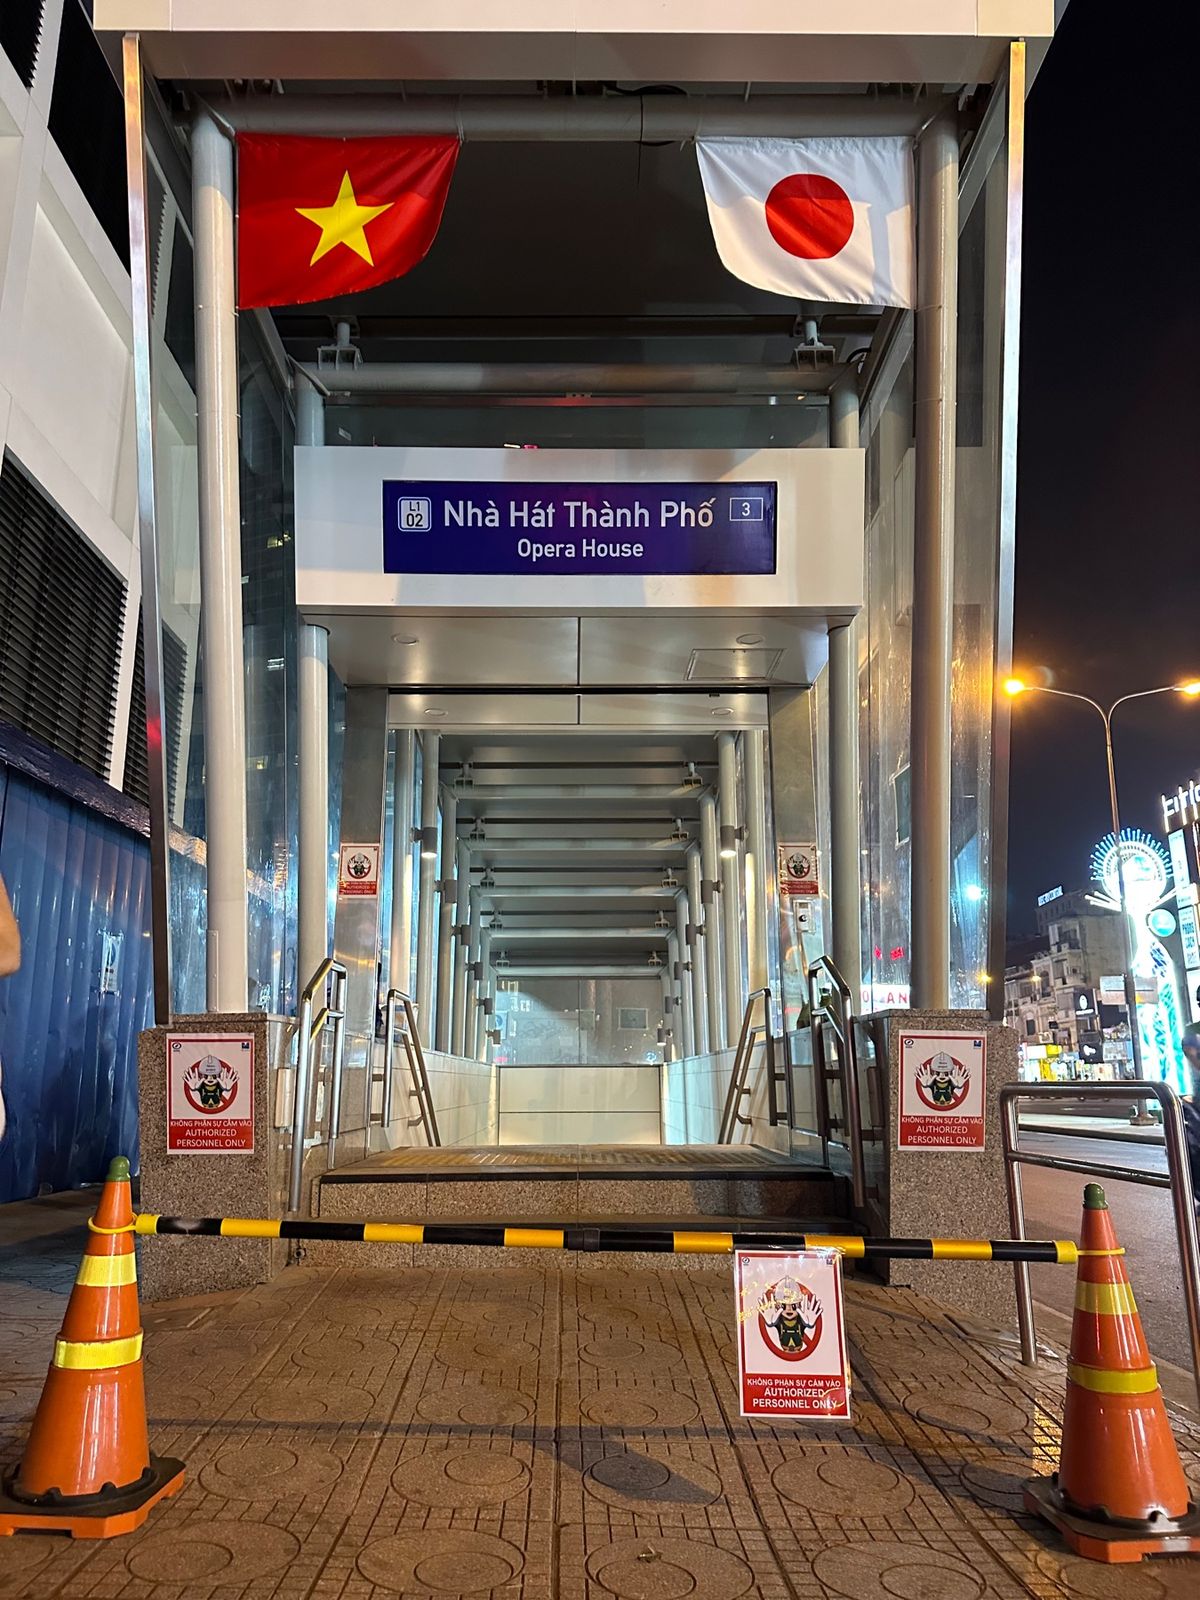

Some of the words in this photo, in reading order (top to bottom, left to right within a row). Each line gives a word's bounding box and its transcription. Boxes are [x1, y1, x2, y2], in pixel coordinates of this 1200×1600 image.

[409, 501, 421, 512] L1
[741, 502, 751, 517] 3
[444, 500, 500, 528] Nhà
[509, 500, 556, 528] Hát
[563, 500, 649, 528] Thành
[660, 497, 717, 528] Phố
[406, 513, 424, 527] 02
[517, 538, 576, 562] Opera
[582, 538, 644, 558] House
[185, 1128, 237, 1137] AUTHORIZED
[916, 1125, 968, 1134] AUTHORIZED
[176, 1139, 224, 1147] PERSONNEL
[224, 1139, 246, 1147] ONLY
[907, 1135, 954, 1144] PERSONNEL
[955, 1136, 977, 1145] ONLY
[747, 1377, 773, 1386] KHÔNG
[764, 1387, 824, 1397] AUTHORIZED
[752, 1398, 810, 1408] PERSONNEL
[812, 1399, 838, 1409] ONLY
